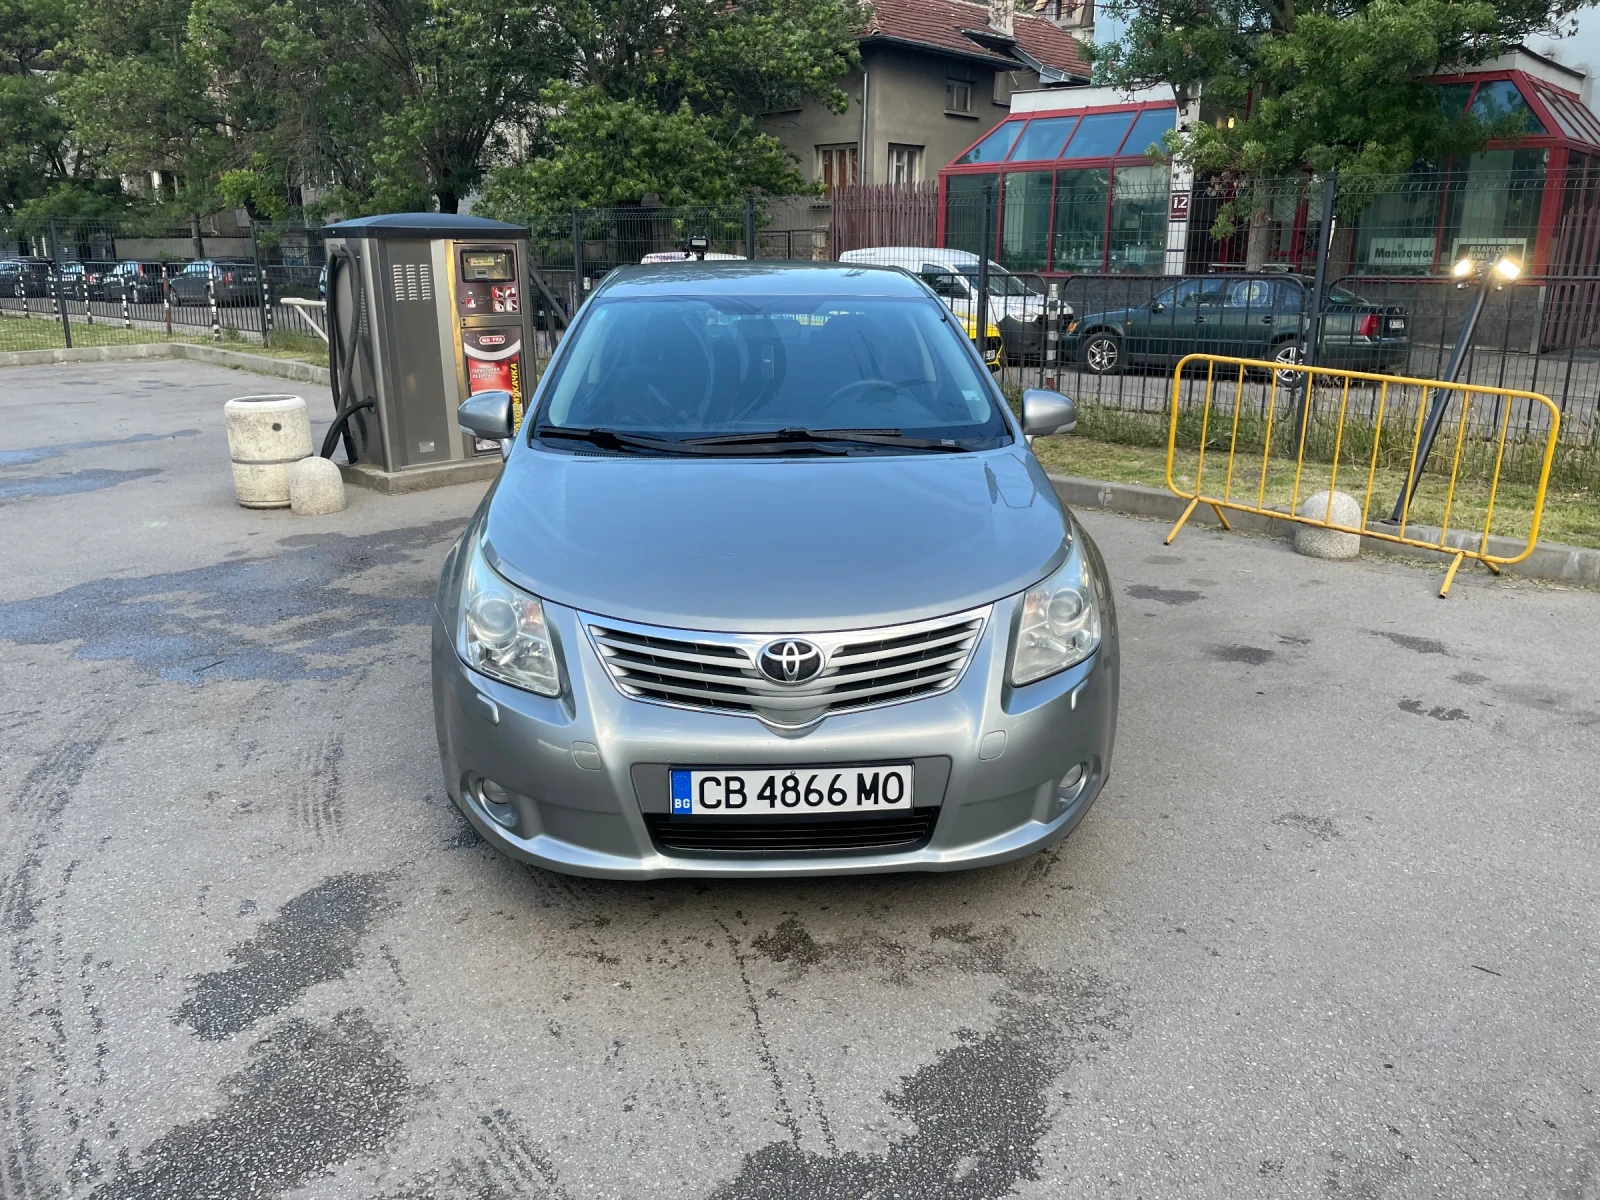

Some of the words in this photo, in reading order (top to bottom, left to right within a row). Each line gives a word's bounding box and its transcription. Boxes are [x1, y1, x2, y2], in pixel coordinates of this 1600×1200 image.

[1174, 197, 1187, 208] 12
[699, 776, 747, 809] CB
[757, 774, 848, 808] 4866
[857, 771, 904, 806] MO
[674, 798, 690, 809] BG
